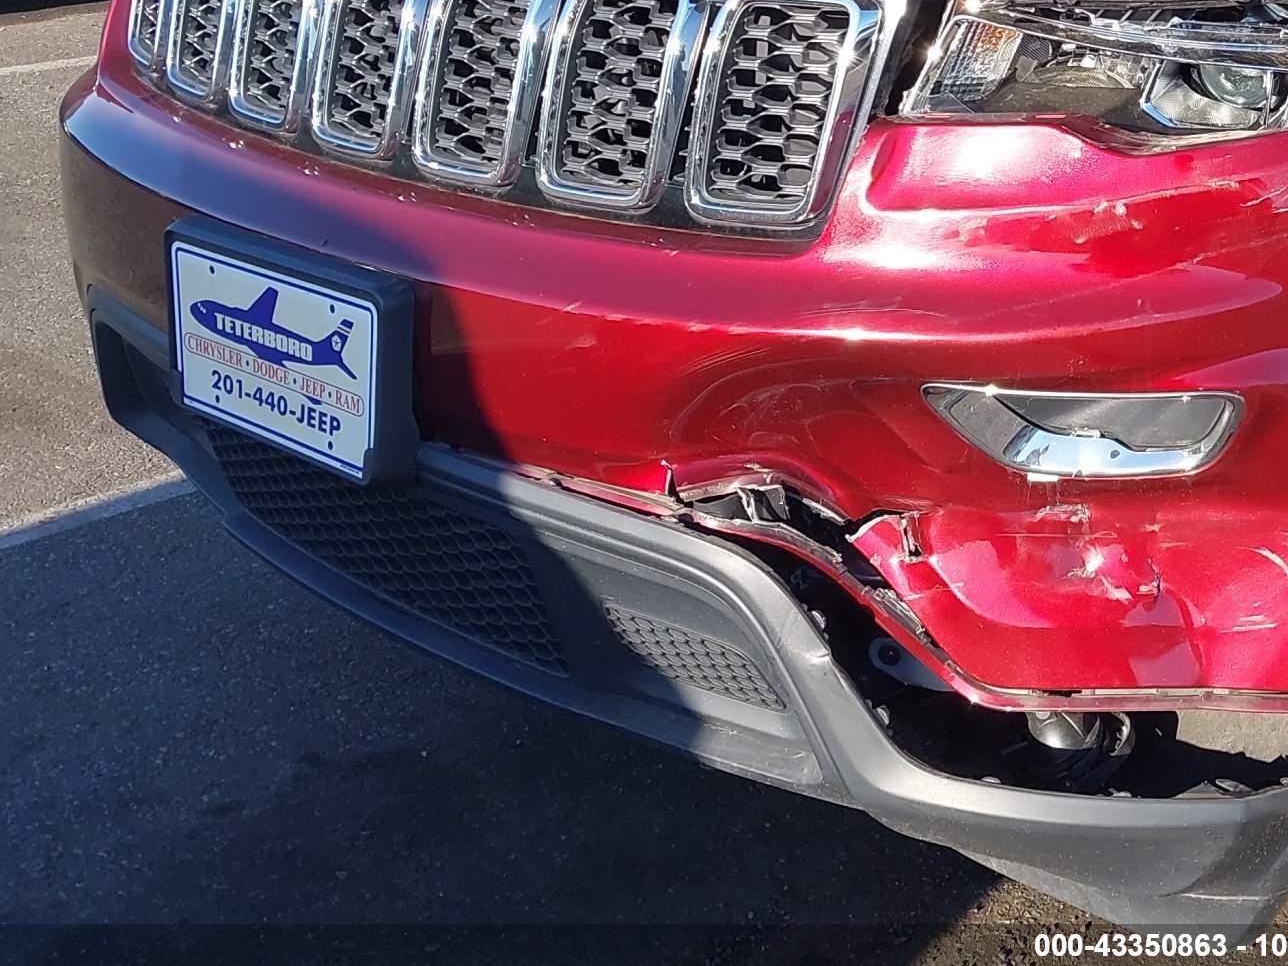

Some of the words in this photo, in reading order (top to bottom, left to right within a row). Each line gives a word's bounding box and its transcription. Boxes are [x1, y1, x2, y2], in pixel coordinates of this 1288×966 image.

[214, 312, 313, 362] TETERBORO
[187, 334, 243, 369] CHRYSLER
[252, 359, 291, 386] DODGE
[300, 380, 327, 401] JEEP
[335, 390, 361, 415] RAM
[211, 369, 341, 436] 201-440-JEEP
